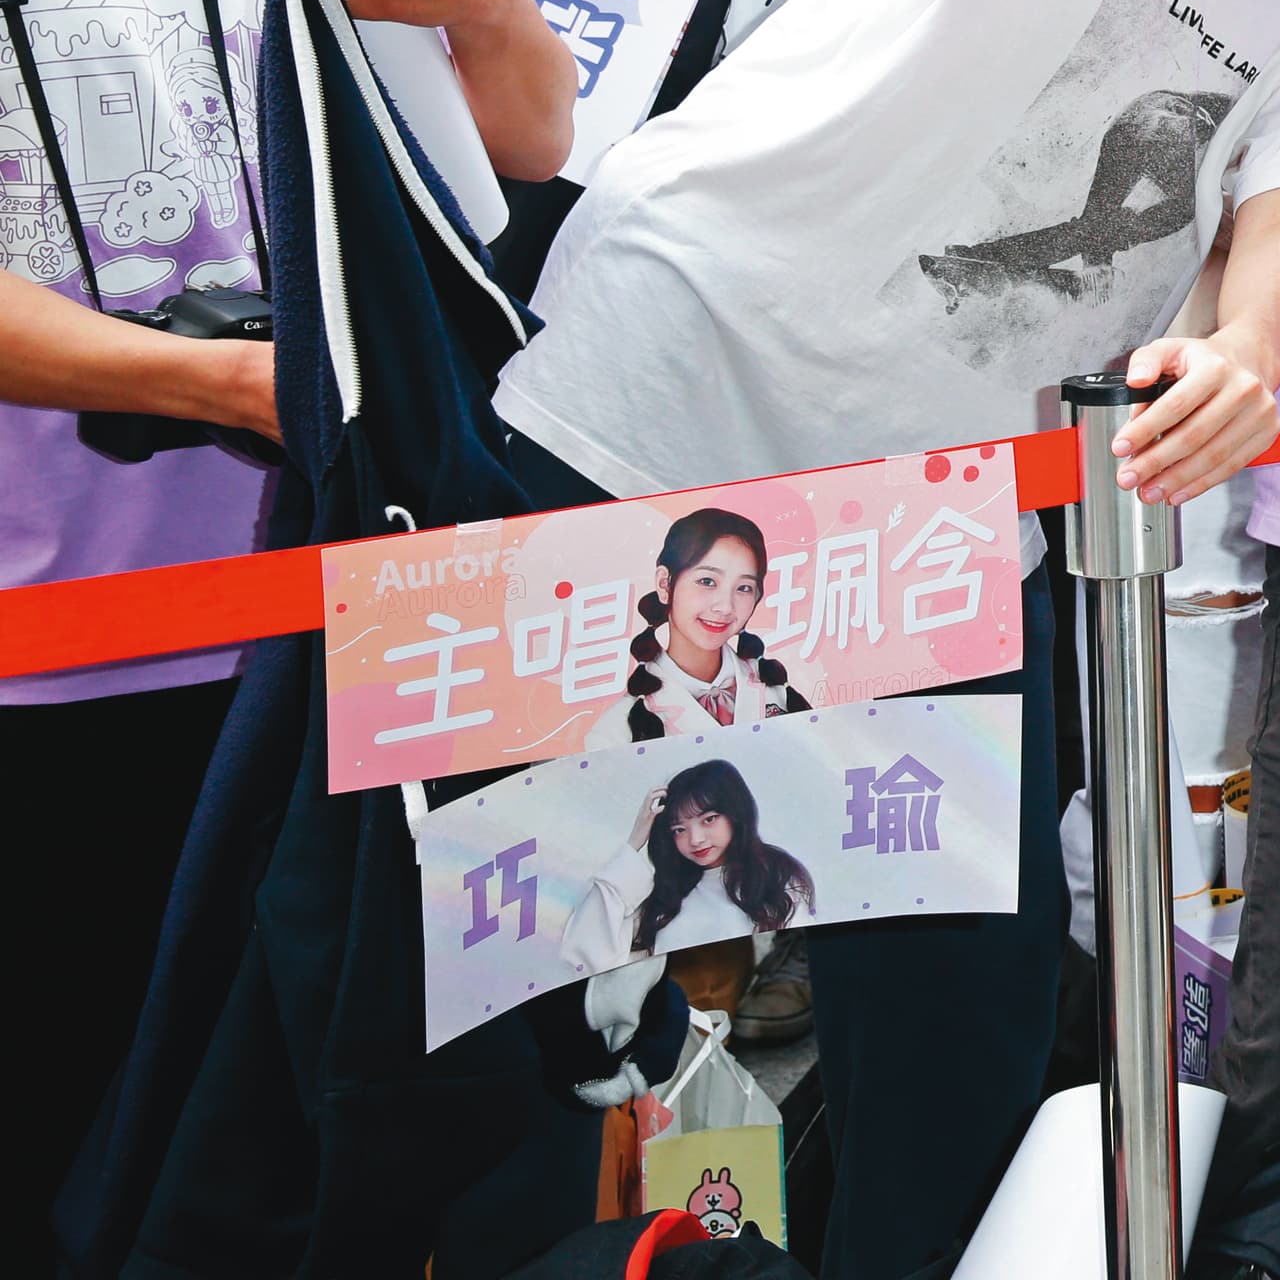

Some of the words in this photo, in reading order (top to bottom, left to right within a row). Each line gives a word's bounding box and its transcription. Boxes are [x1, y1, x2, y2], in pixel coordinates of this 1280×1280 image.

[374, 546, 525, 595] Aurora
[373, 579, 634, 746] 主唱
[461, 838, 539, 952] 巧
[841, 752, 945, 856] 瑜
